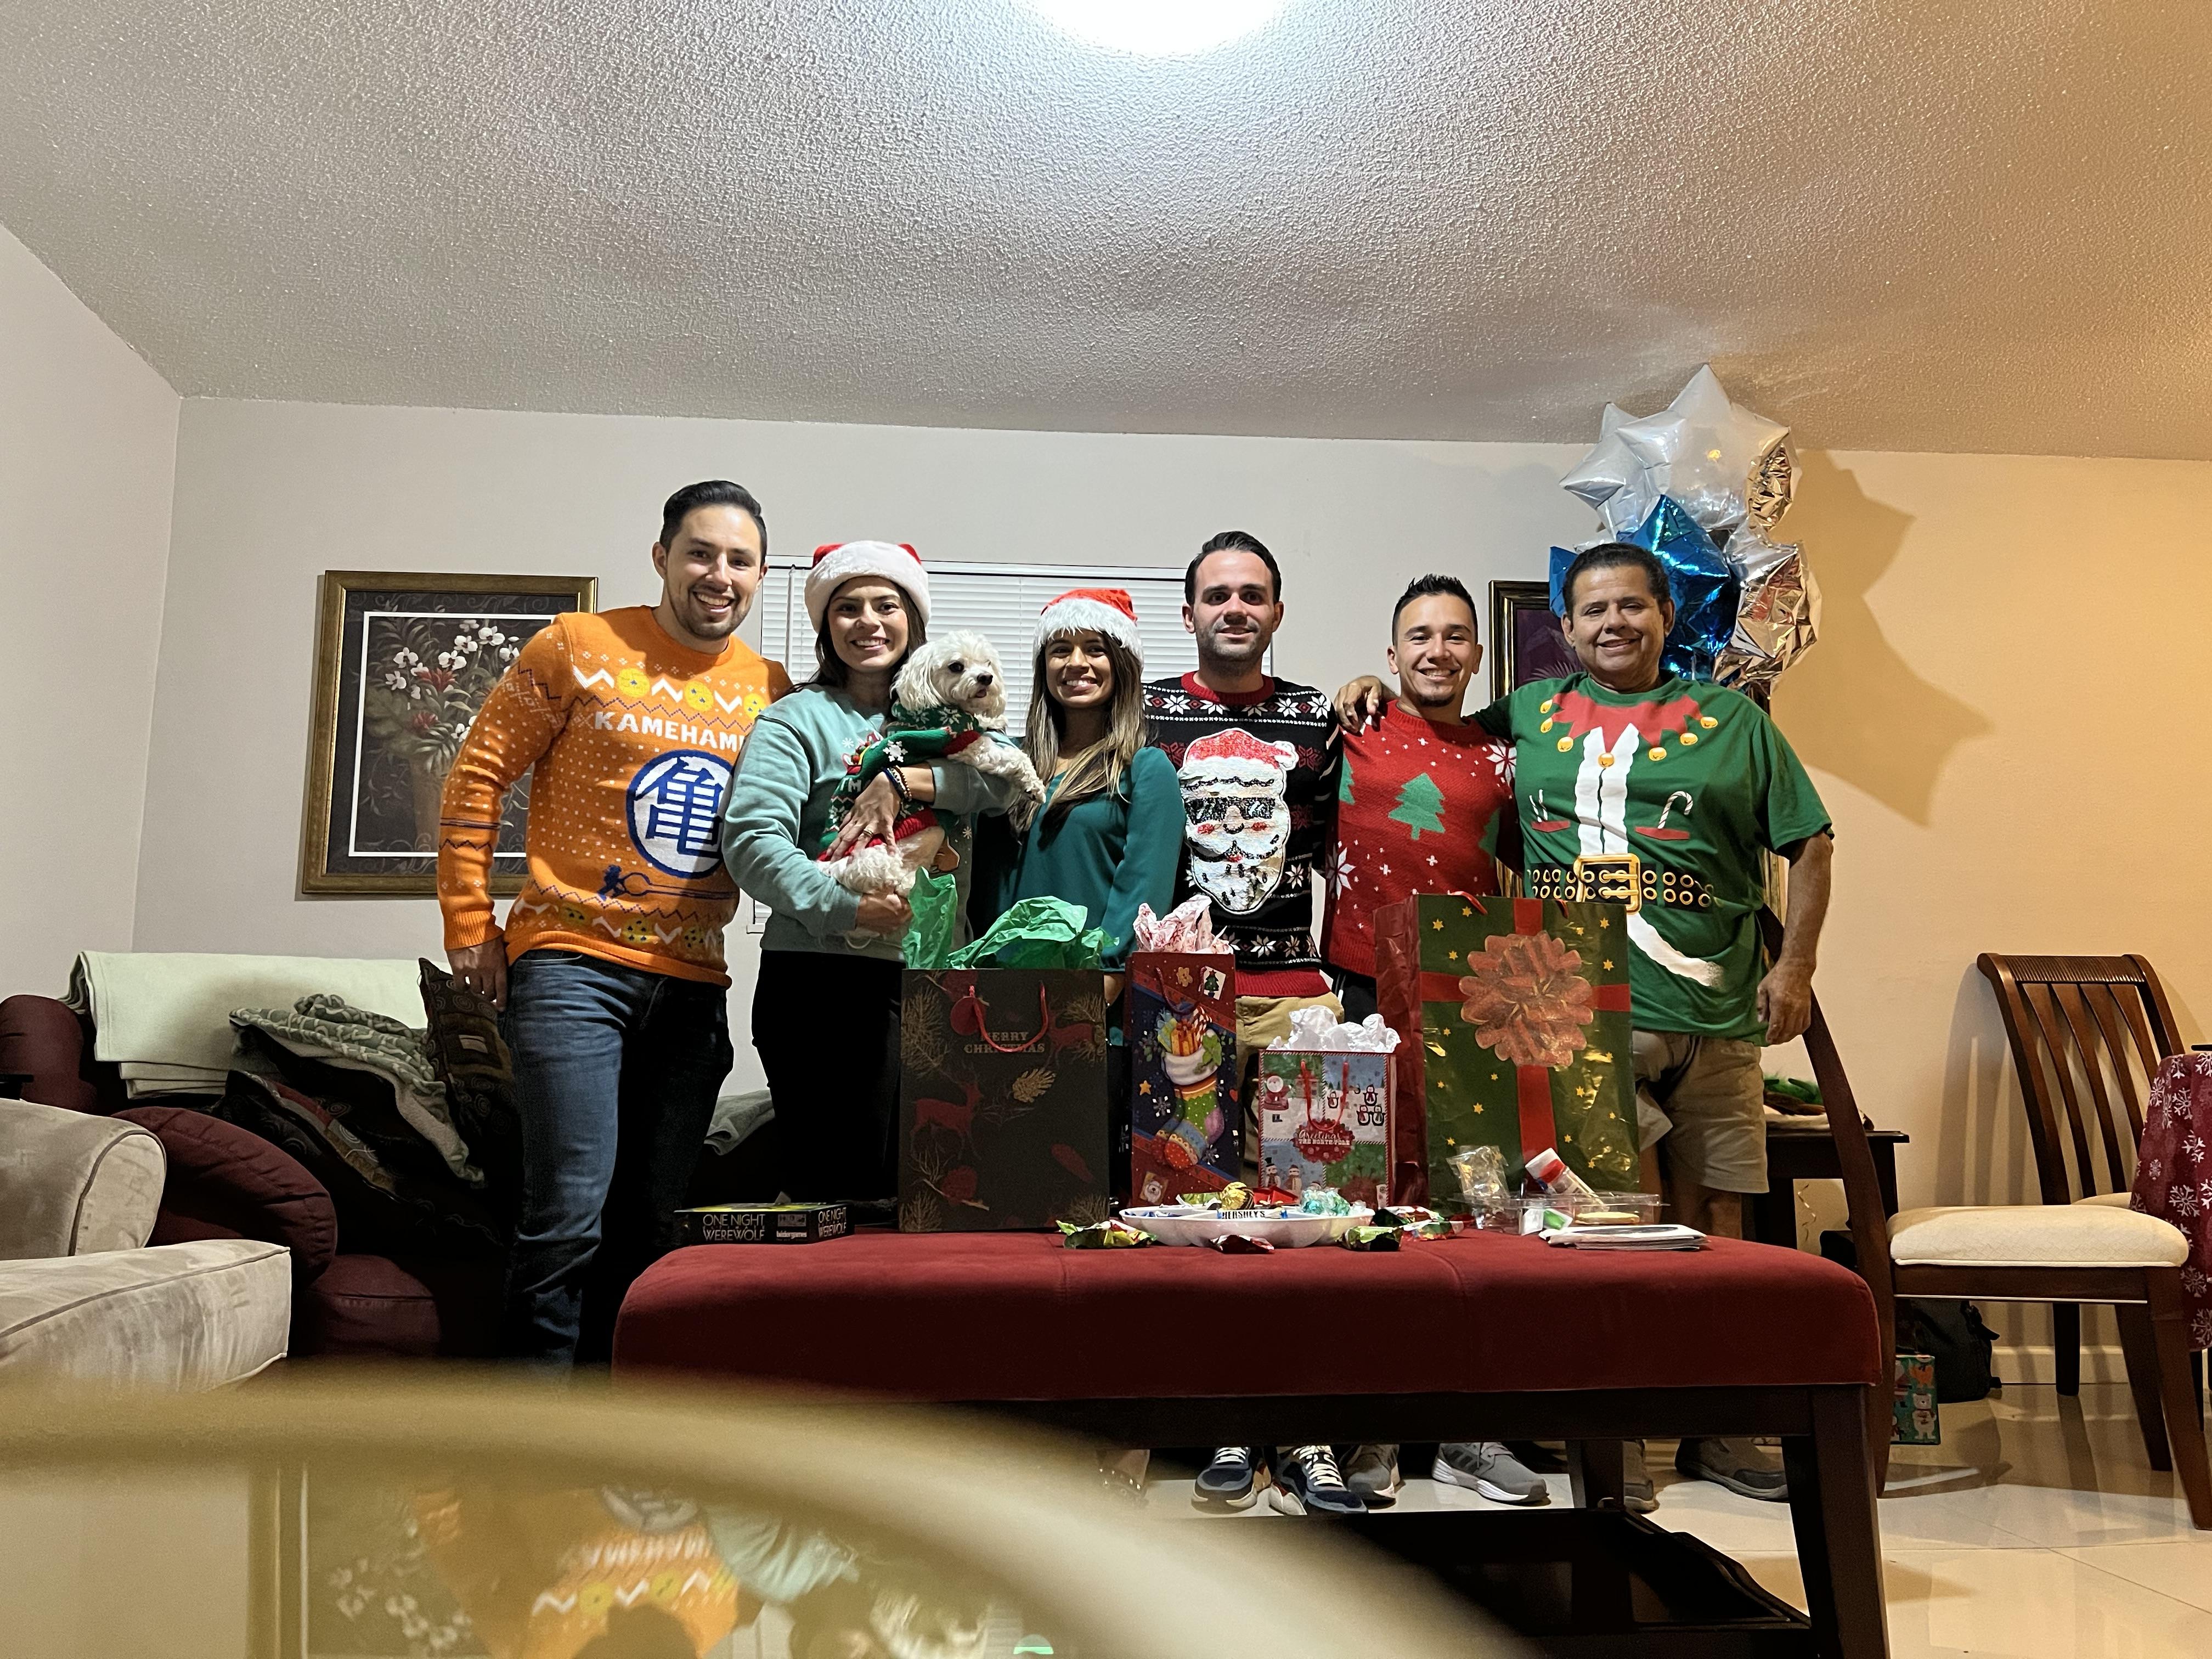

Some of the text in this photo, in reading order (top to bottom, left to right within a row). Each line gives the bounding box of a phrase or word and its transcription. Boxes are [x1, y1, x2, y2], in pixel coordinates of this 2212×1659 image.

[963, 1043, 1045, 1053] CHRAS
[703, 1214, 766, 1226] ONE NIGHT
[818, 1210, 830, 1223] ONE
[831, 1206, 847, 1221] NIGHT
[703, 1229, 765, 1241] WEREWOLF
[818, 1222, 847, 1238] WEREWOLF
